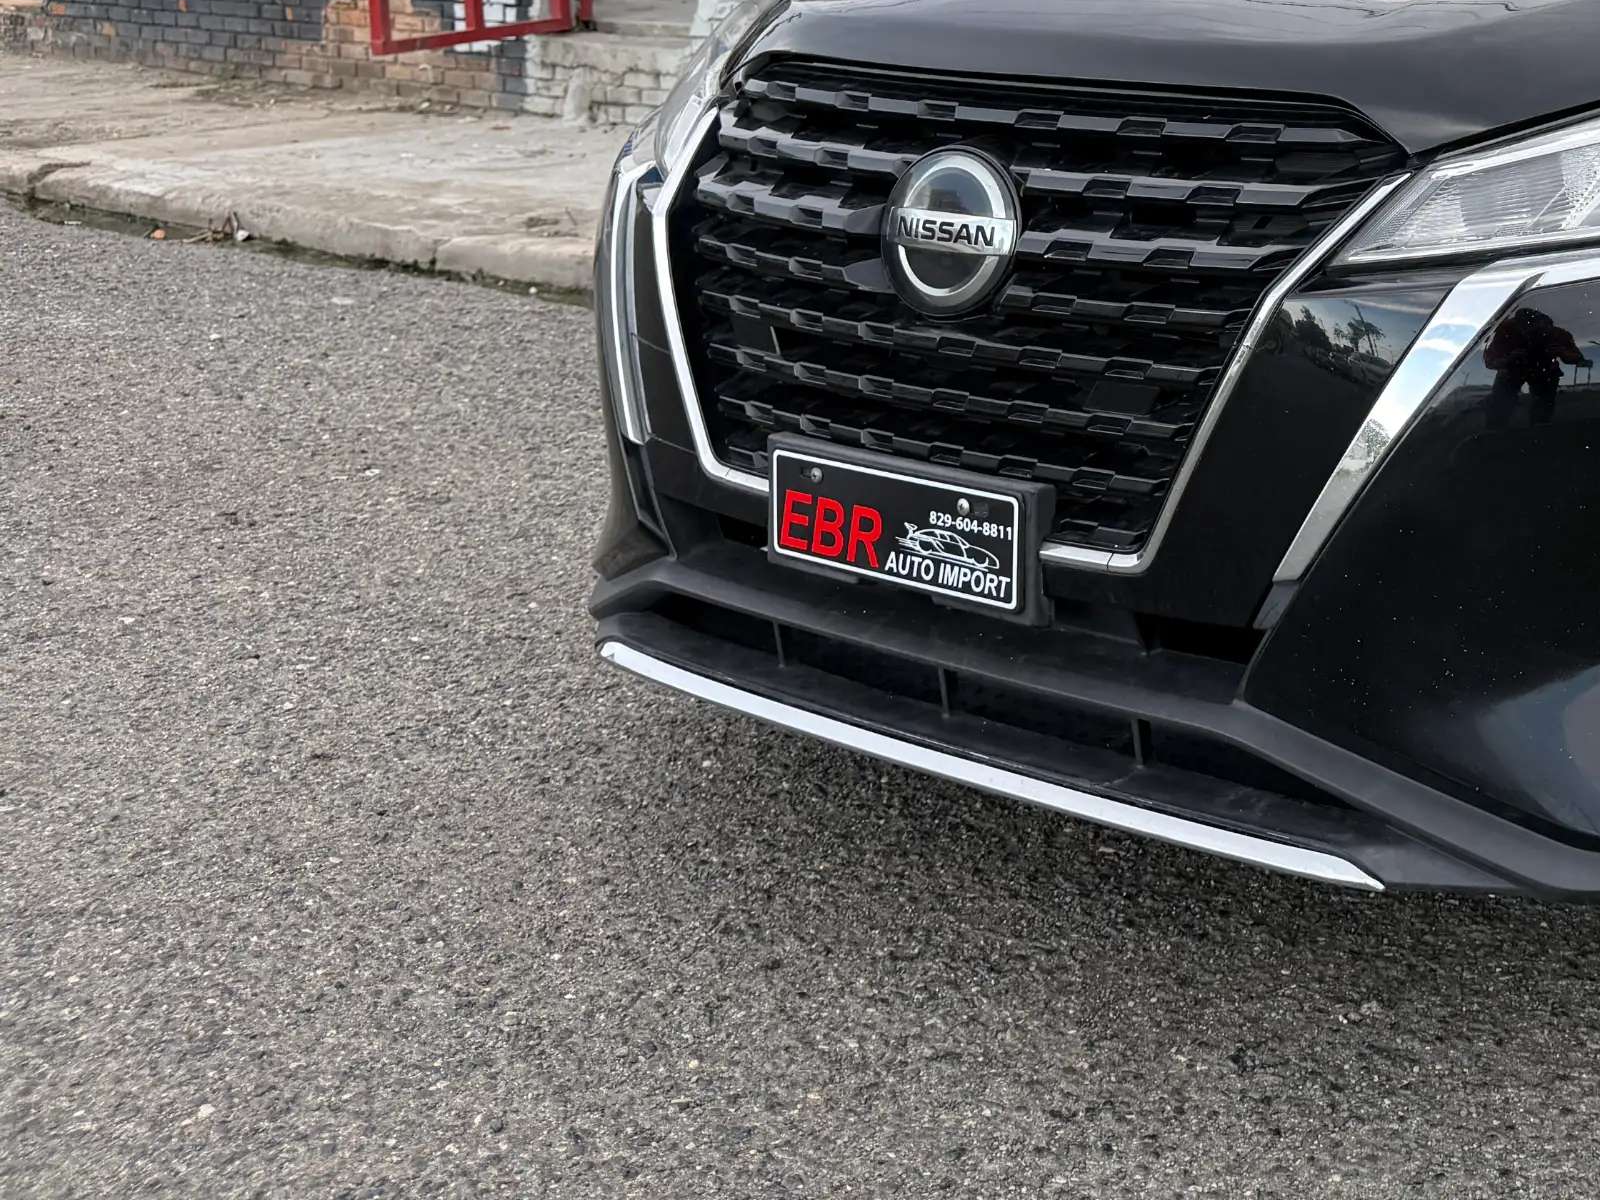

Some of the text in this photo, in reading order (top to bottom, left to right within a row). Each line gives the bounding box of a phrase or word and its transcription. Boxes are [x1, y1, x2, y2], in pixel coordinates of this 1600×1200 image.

[897, 213, 996, 247] NISSAN
[778, 488, 883, 569] EBR
[929, 510, 1012, 541] 829-604-8811
[884, 551, 1011, 598] AUTO IMPORT
